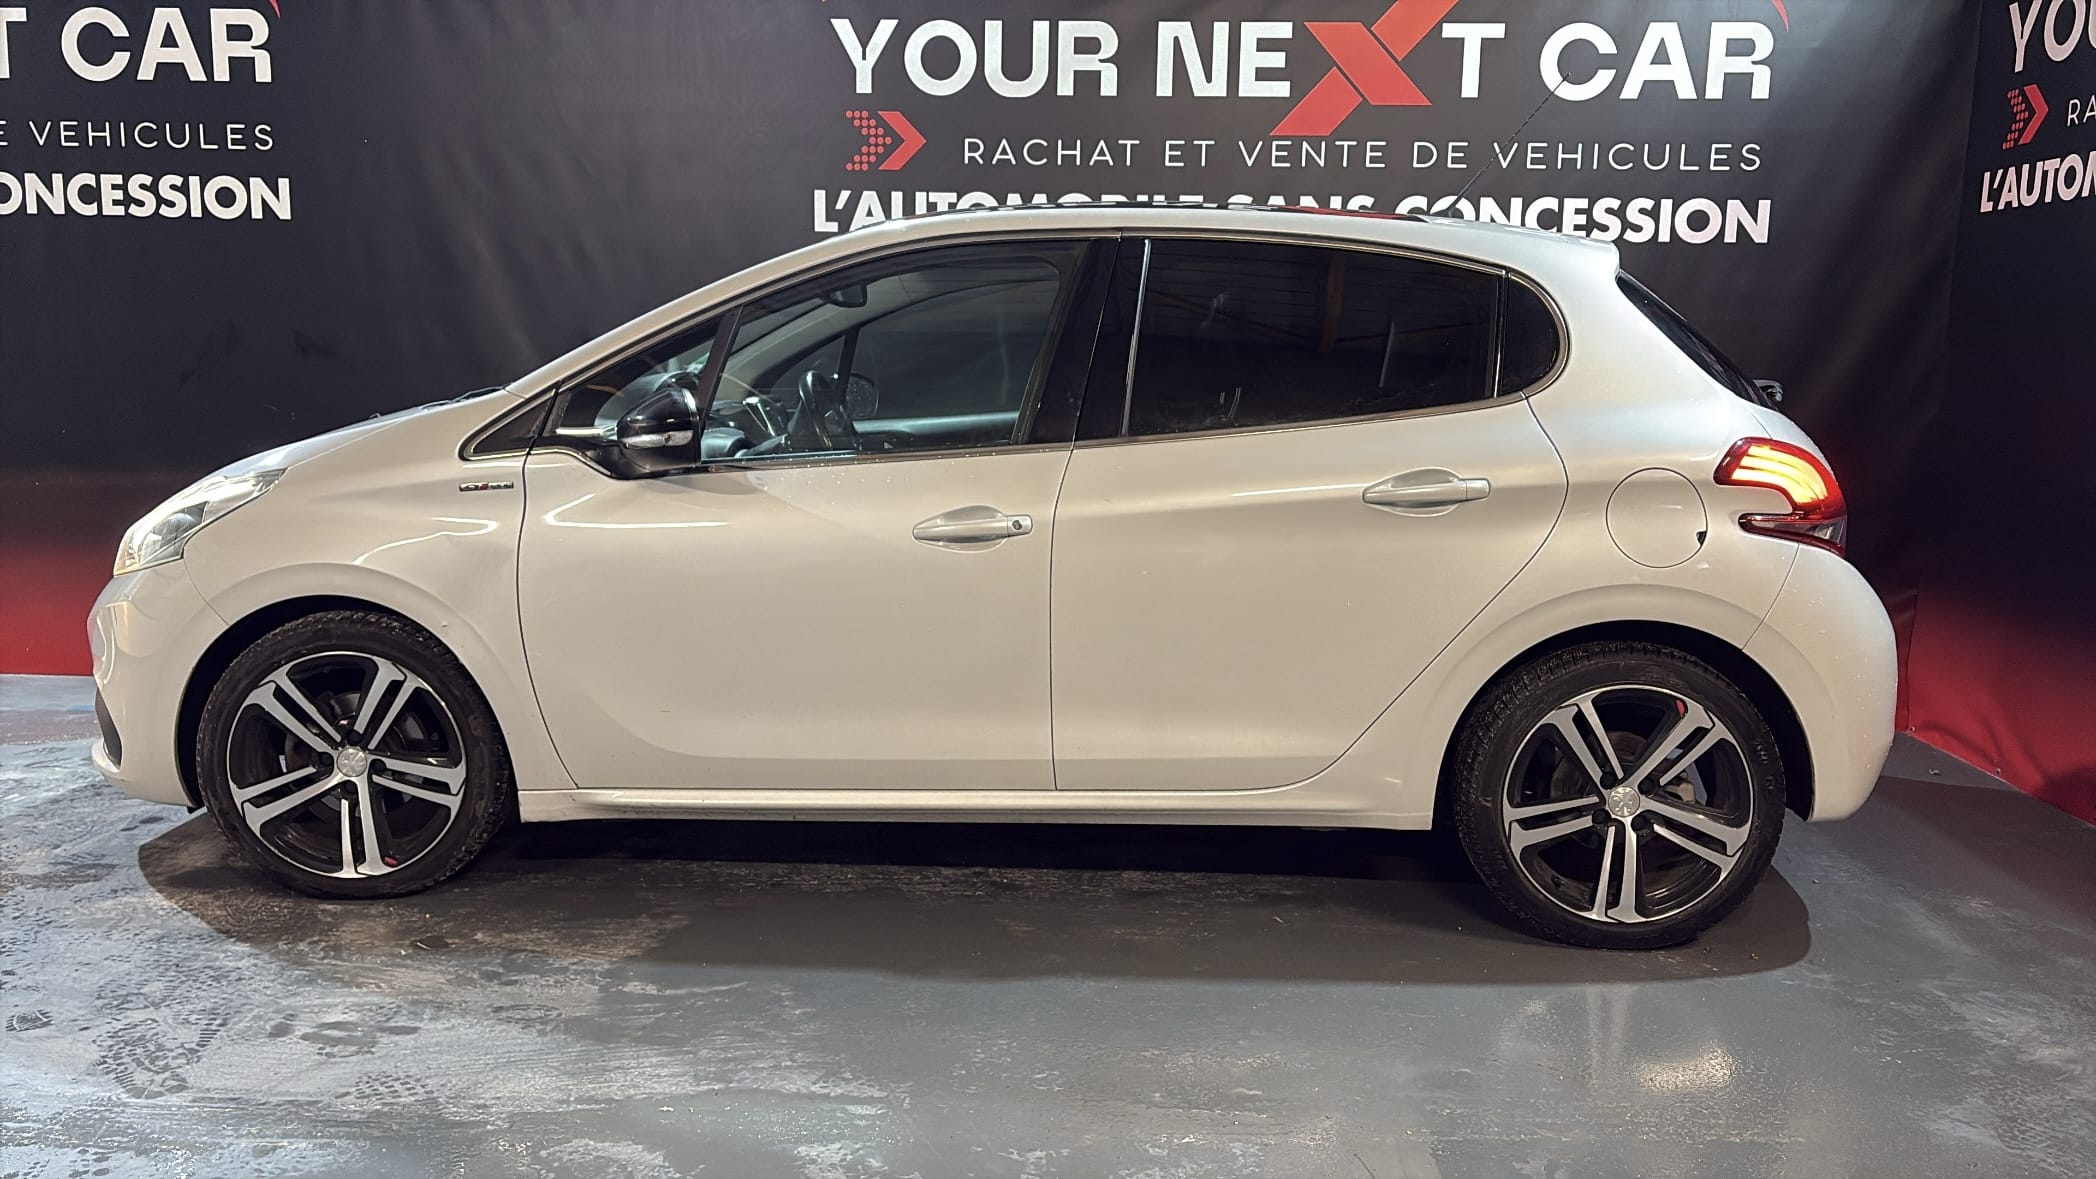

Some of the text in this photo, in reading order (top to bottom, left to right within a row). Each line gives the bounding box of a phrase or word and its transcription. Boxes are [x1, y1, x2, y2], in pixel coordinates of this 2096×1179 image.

[61, 7, 272, 82] CAR
[830, 18, 1119, 98] YOUR
[1539, 21, 1775, 101] CAR
[2009, 0, 2096, 73] YO
[28, 120, 273, 151] VEHICULES
[963, 138, 1762, 171] RACHAT ET VENTE DE VEHICULES
